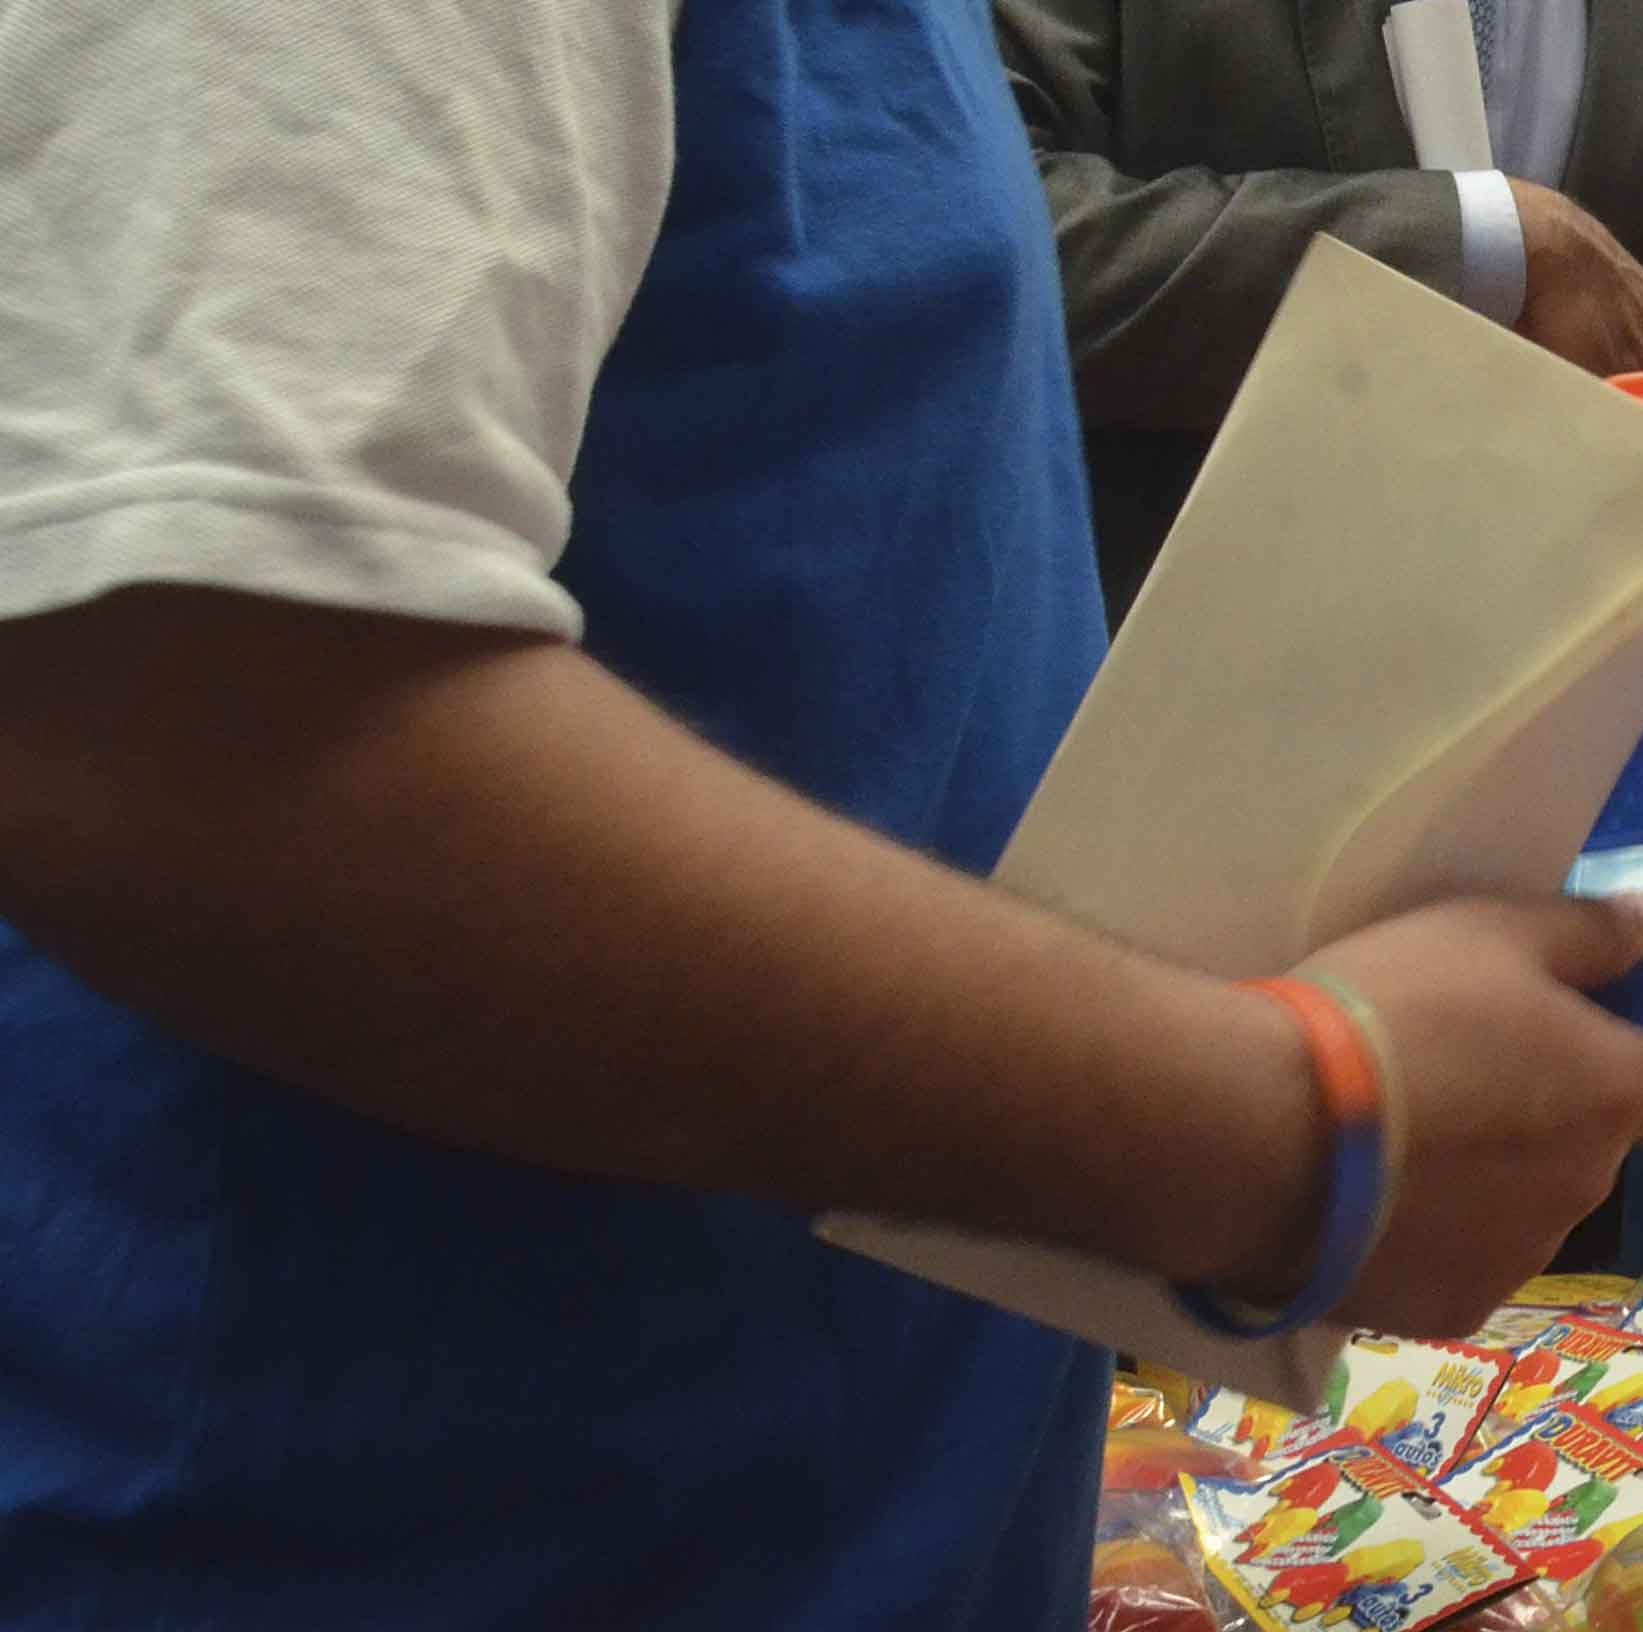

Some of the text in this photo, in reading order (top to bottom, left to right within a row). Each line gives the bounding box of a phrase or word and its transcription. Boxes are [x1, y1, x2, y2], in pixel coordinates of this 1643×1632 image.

[1541, 1322, 1632, 1362] DURAVIT
[1432, 1360, 1484, 1399] Mikro
[1423, 1411, 1447, 1439] 3
[1392, 1442, 1444, 1468] autos
[1401, 1583, 1434, 1605] 3
